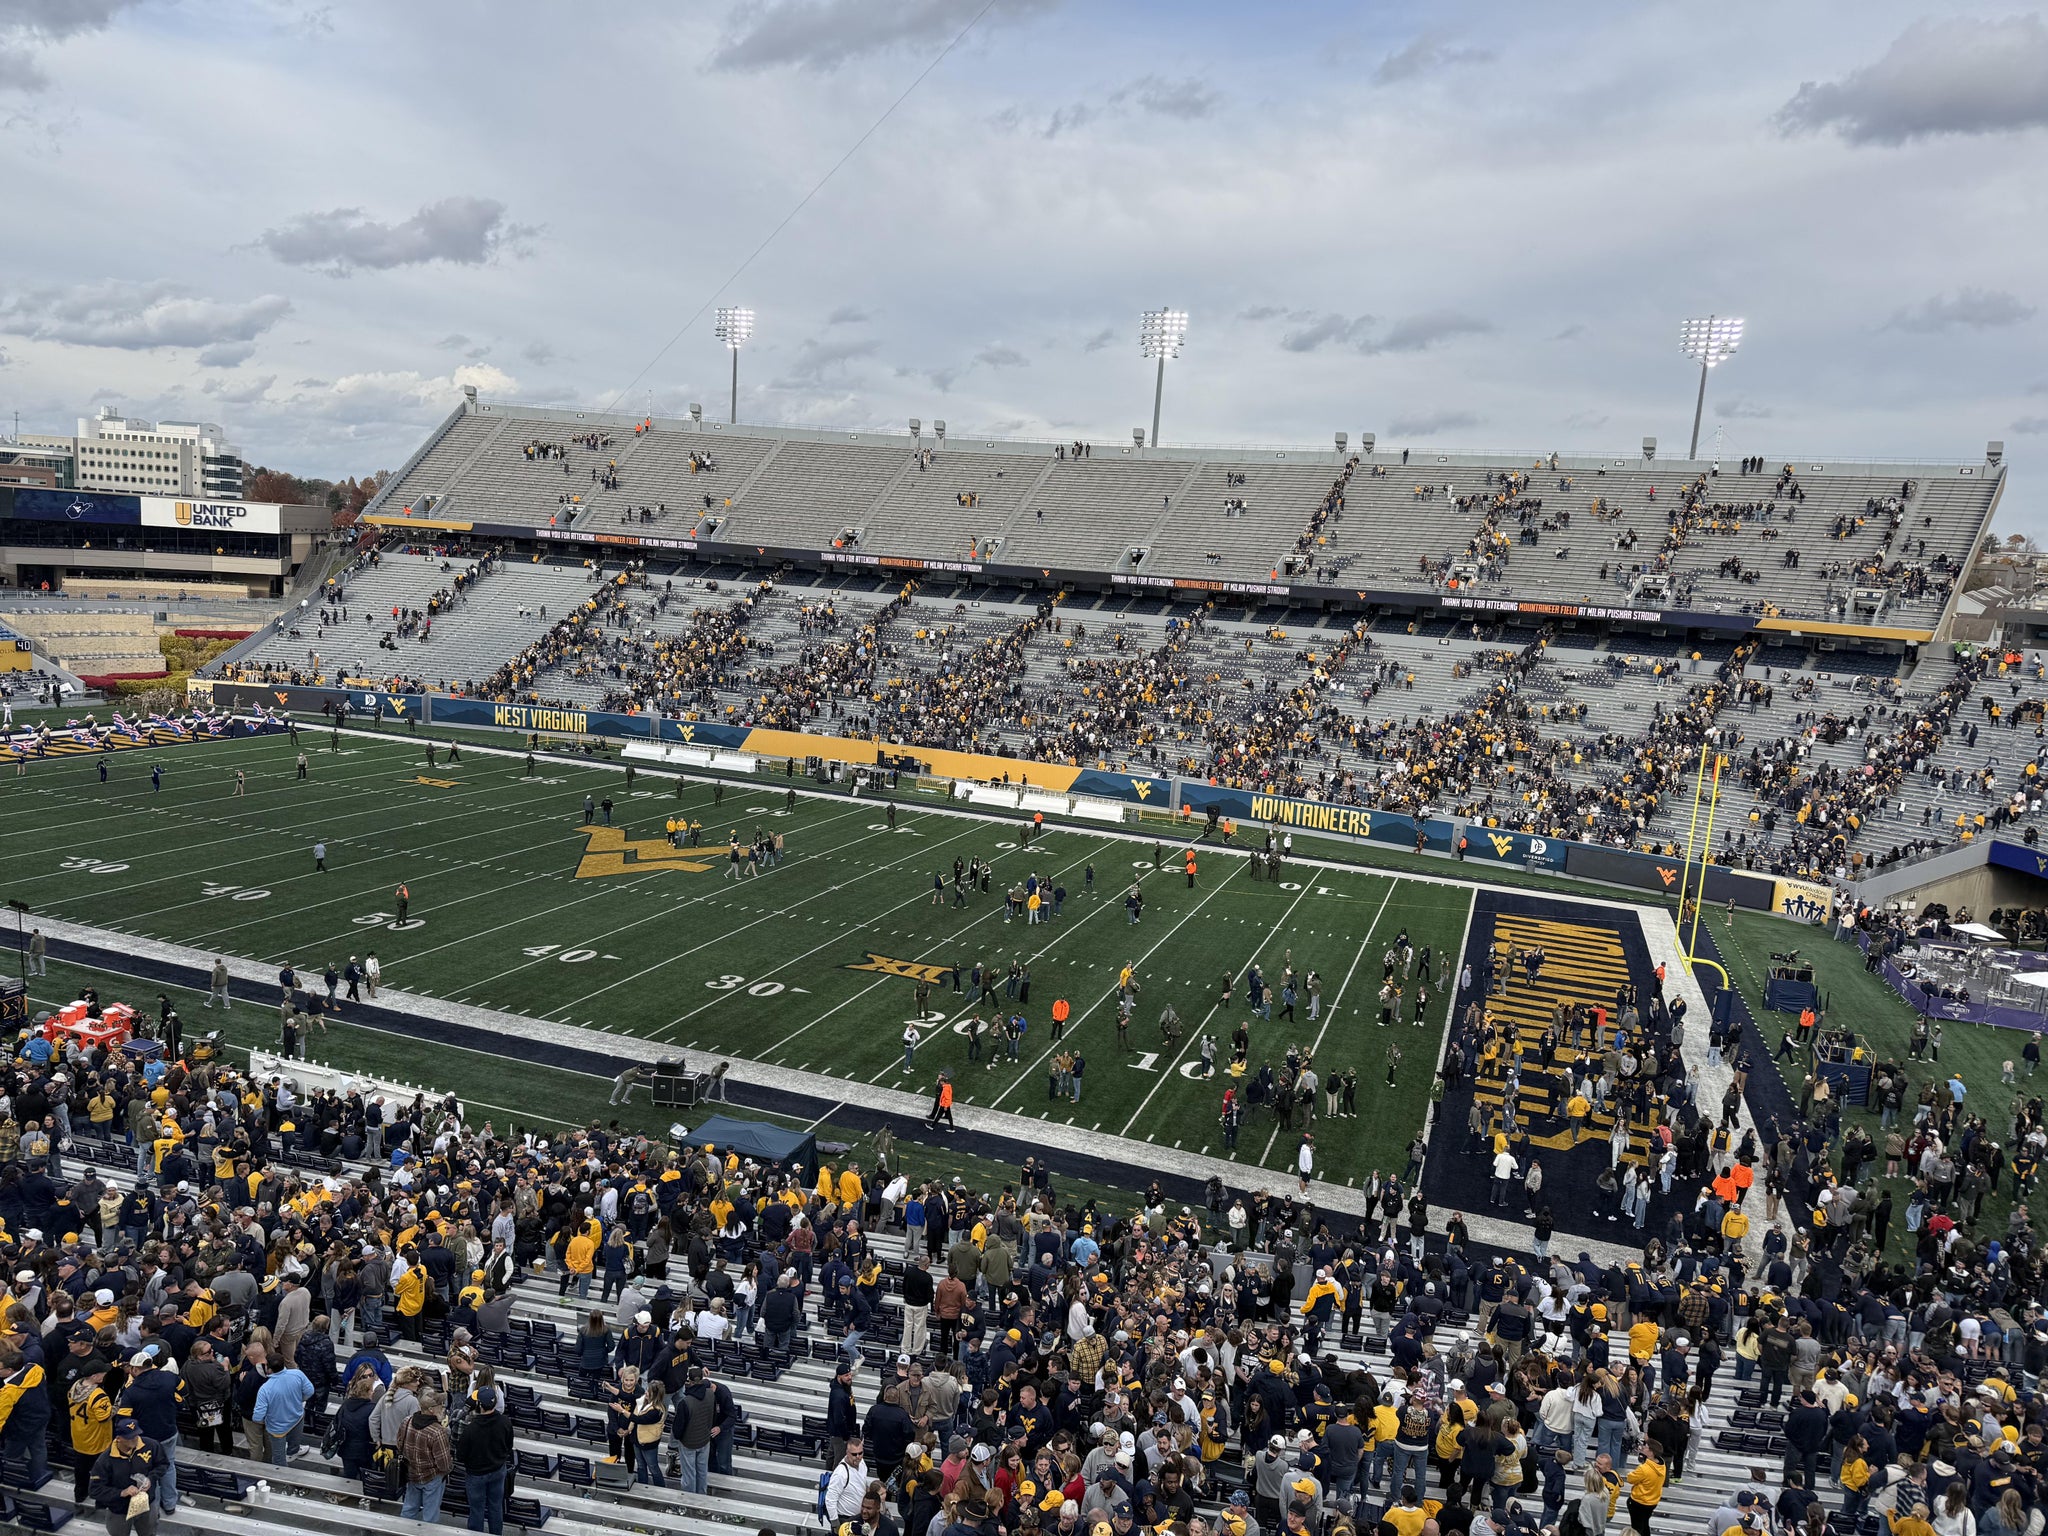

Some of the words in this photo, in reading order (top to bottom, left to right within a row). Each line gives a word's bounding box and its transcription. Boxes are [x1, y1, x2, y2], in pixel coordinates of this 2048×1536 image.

[193, 504, 247, 517] UNITED
[193, 515, 233, 528] BANK
[561, 532, 570, 540] FOR
[626, 536, 638, 545] FIELD
[639, 538, 645, 546] AT
[836, 554, 845, 562] YOU
[846, 554, 854, 562] FOR
[910, 560, 923, 568] FIELD
[924, 560, 929, 568] AT
[1128, 576, 1137, 584] YOU
[1138, 576, 1148, 584] FOR
[1148, 577, 1174, 586] ATTENDING
[1209, 581, 1222, 590] FIELD
[1223, 582, 1230, 591] AT
[1230, 583, 1245, 592] MILAN
[1442, 598, 1460, 607] THANK
[1461, 599, 1472, 608] YOU
[1474, 599, 1485, 609] FOR
[1486, 600, 1518, 611] ATTENDING
[1519, 603, 1560, 614] MOUNTAINEER
[1560, 605, 1577, 615] FIELD
[1578, 606, 1586, 616] AT
[1587, 607, 1606, 618] MILAN
[1634, 611, 1660, 621] STADIUM
[18, 641, 30, 650] 40
[494, 706, 527, 728] WEST
[530, 709, 587, 733] VIRGINIA
[1250, 796, 1371, 836] MOUNTAINEERS
[59, 857, 130, 874] 30
[200, 884, 272, 902] 40
[522, 944, 598, 962] 40
[704, 974, 785, 996] 30
[903, 1010, 988, 1035] 20
[1127, 1050, 1216, 1080] 10
[1738, 1293, 1748, 1306] 10
